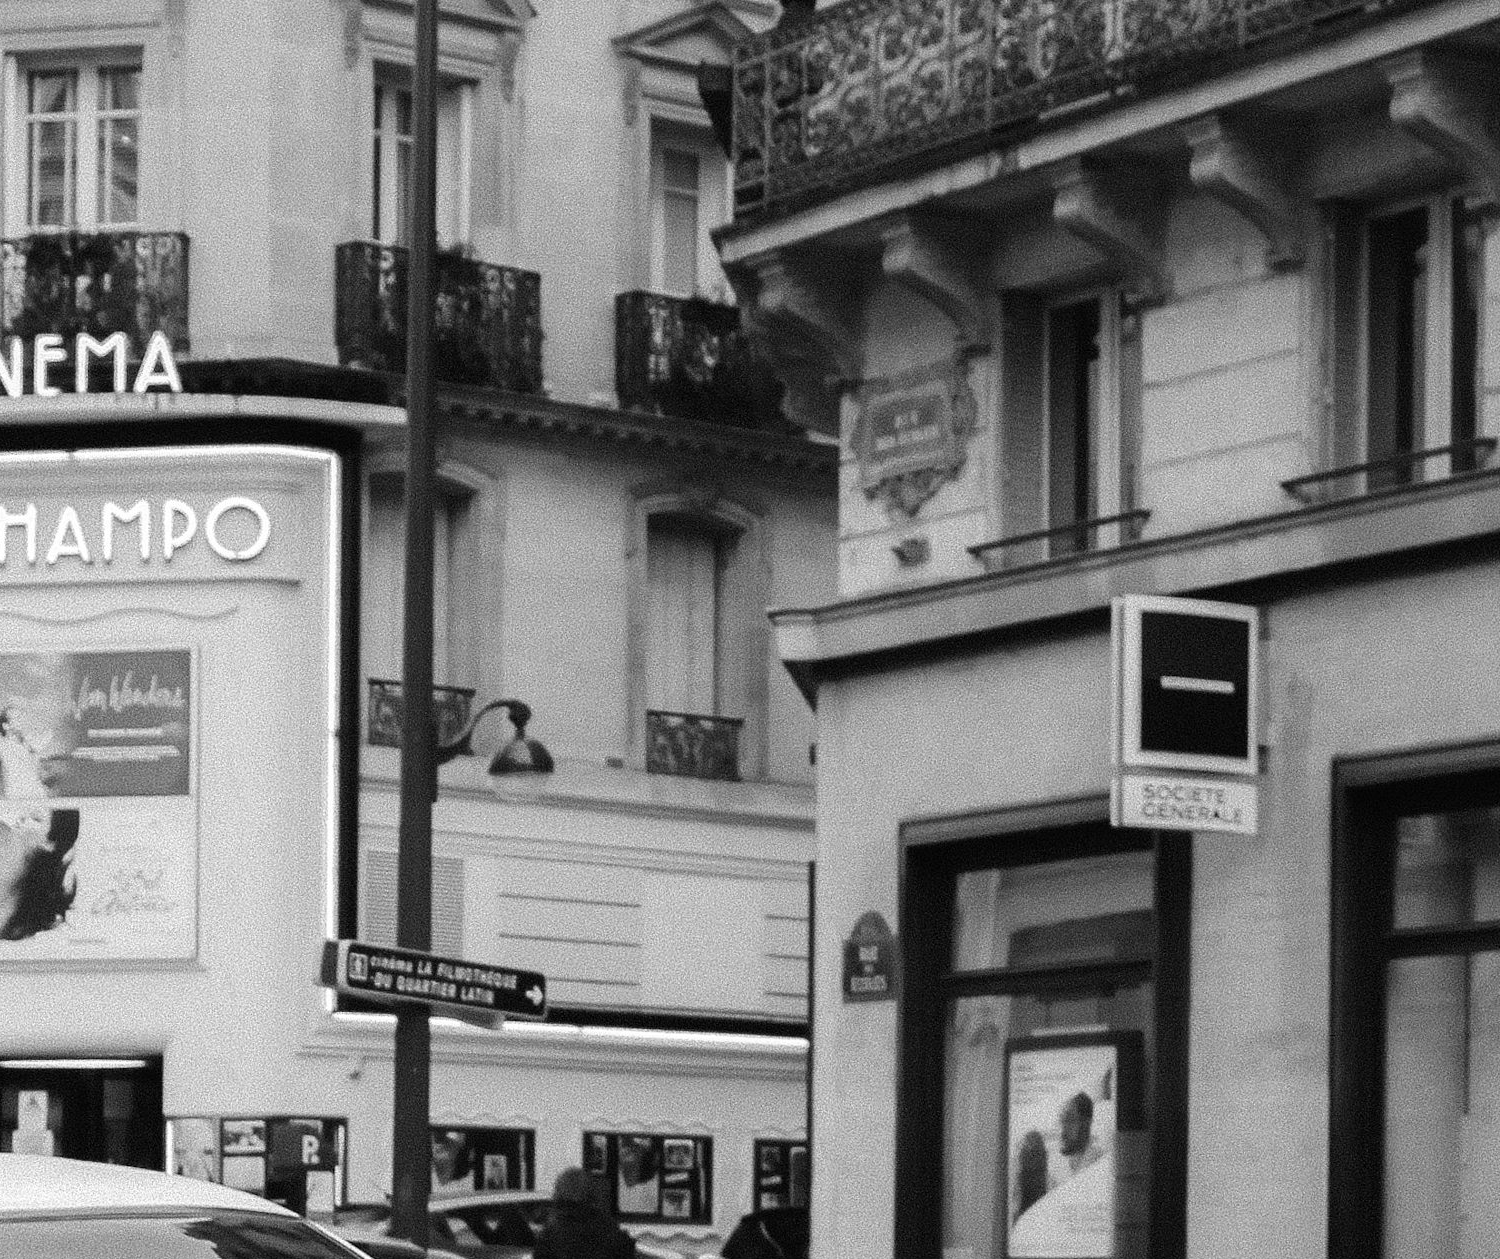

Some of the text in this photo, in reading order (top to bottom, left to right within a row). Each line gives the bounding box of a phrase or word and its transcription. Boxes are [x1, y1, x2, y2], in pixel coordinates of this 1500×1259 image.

[417, 960, 432, 976] LA
[396, 975, 457, 998] QUARTIER
[460, 986, 494, 1004] LATIN
